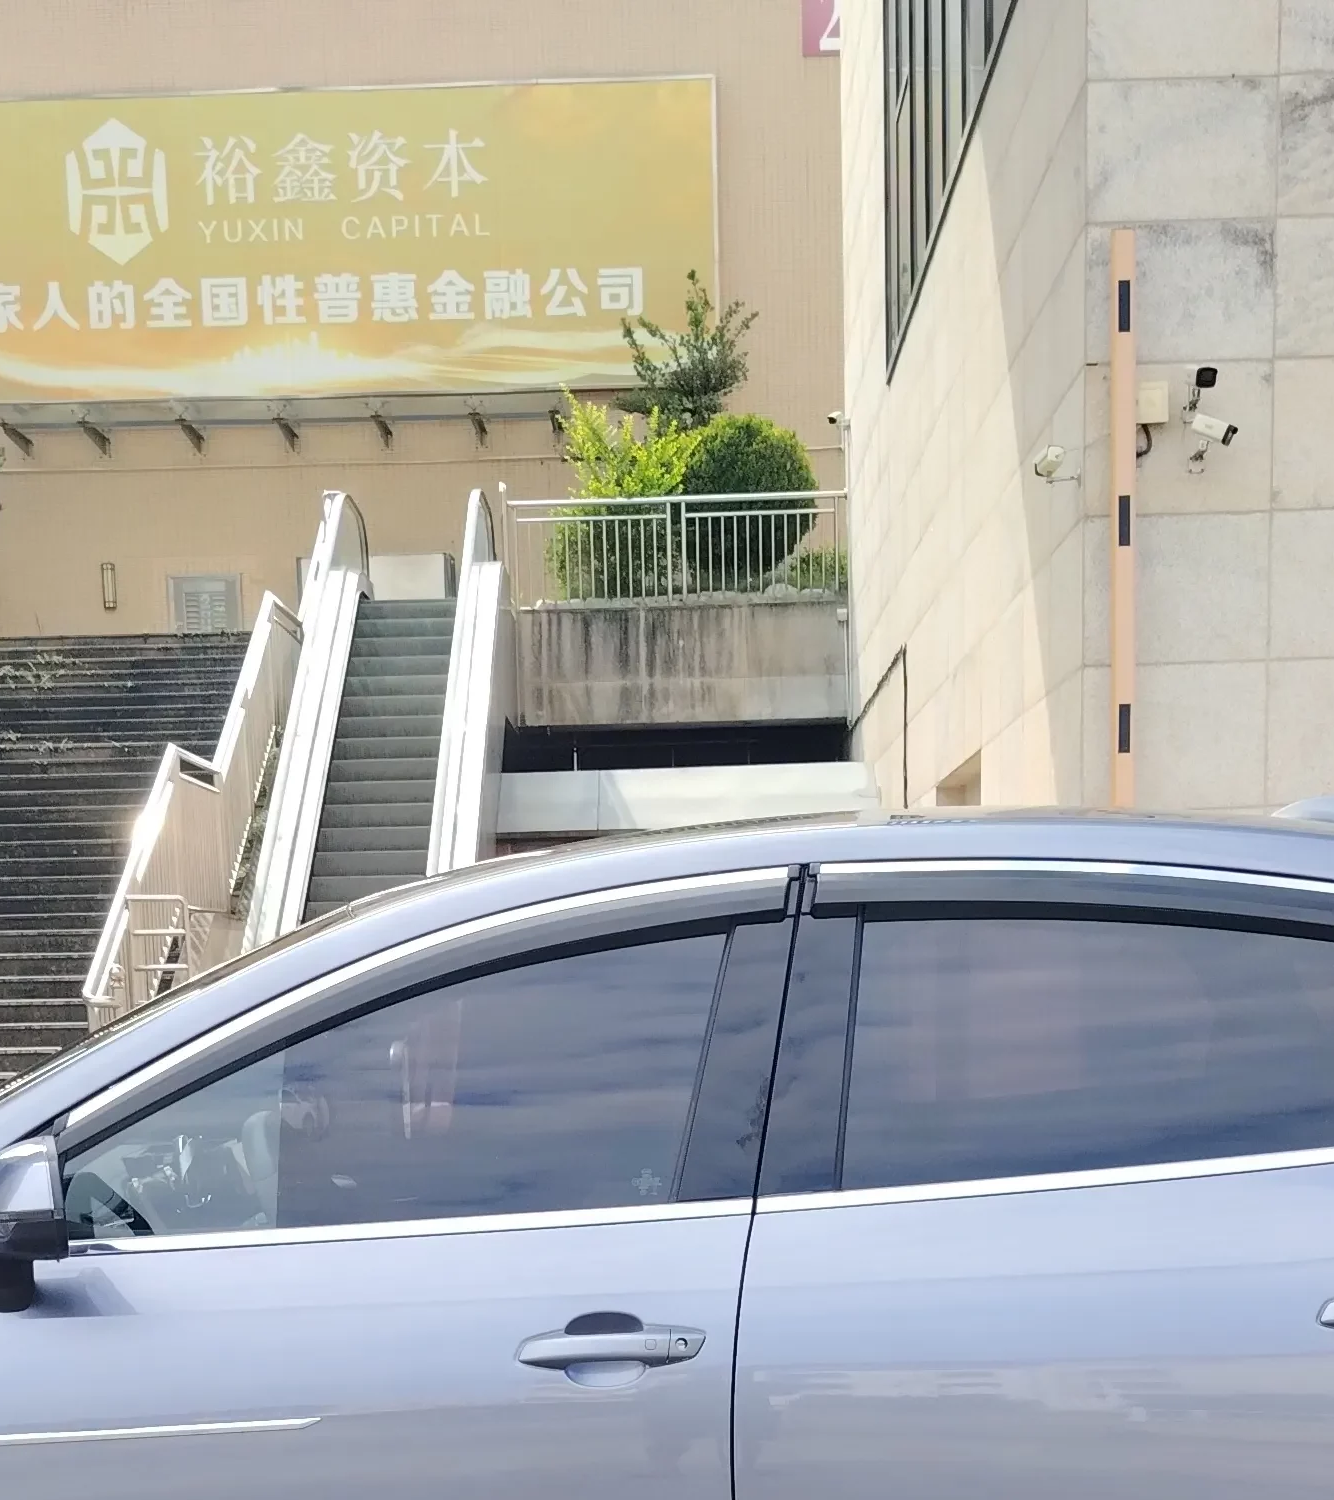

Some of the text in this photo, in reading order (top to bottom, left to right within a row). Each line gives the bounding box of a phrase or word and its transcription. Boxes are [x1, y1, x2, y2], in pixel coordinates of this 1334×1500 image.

[194, 128, 489, 206] 裕鑫资本
[198, 213, 490, 243] YUXIN CAPITAL
